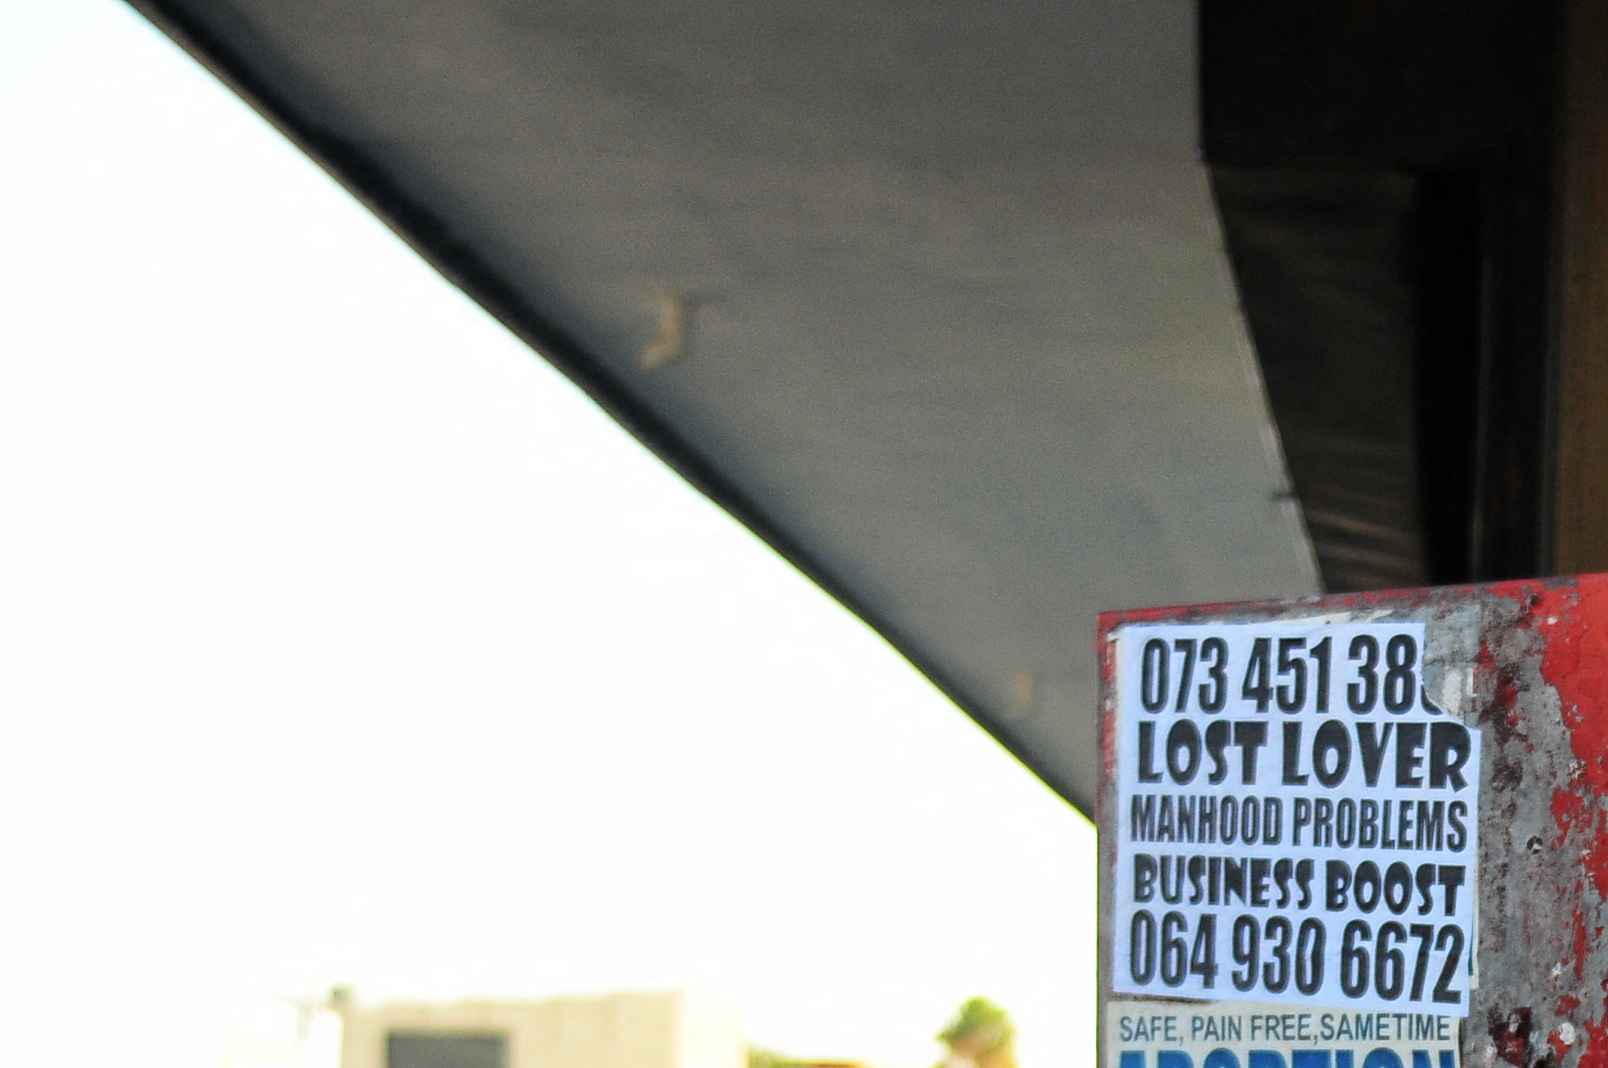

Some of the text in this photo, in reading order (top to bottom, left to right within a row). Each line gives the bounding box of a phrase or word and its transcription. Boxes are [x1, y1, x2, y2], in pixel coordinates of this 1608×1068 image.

[1141, 633, 1444, 715] 073 451 38
[1137, 719, 1471, 793] LOST LOVER
[1130, 794, 1468, 853] MANHOOD PROBLEMS
[1133, 853, 1466, 917] BUSINESS BOOST
[1130, 908, 1219, 989] 064
[1230, 913, 1327, 996] 930
[1340, 918, 1465, 1005] 6672
[1119, 1014, 1185, 1046] SAFE,
[1191, 1014, 1243, 1043] PAIN
